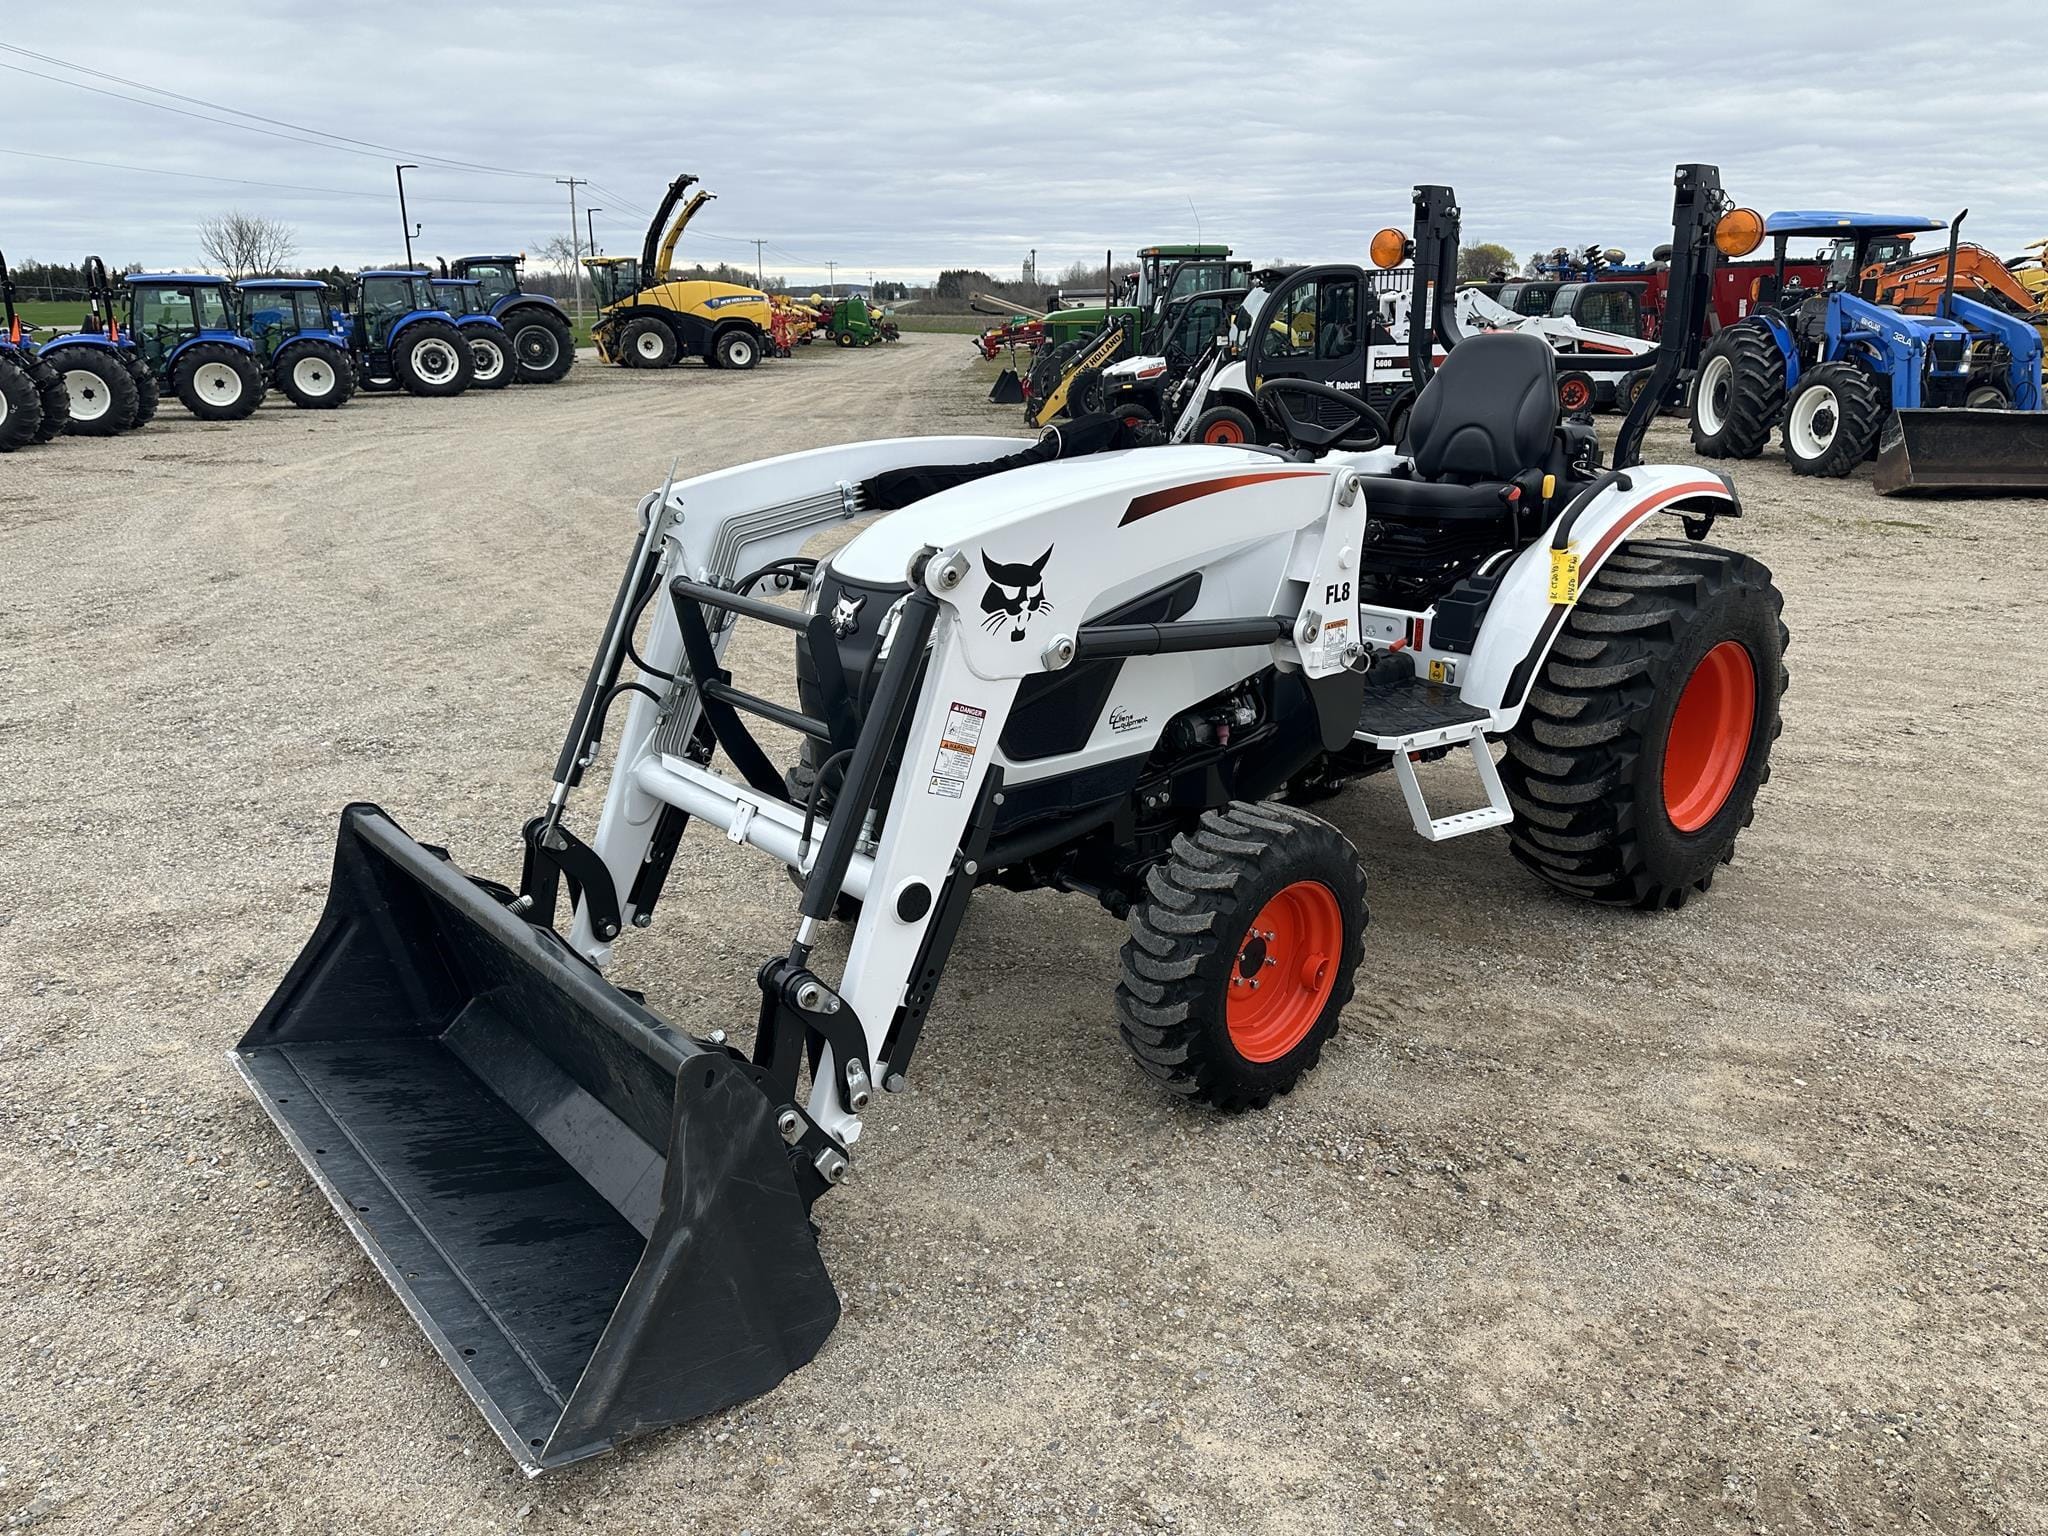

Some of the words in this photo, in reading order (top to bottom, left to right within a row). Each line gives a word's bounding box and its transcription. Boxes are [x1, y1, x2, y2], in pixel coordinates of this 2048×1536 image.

[1904, 266, 1936, 280] DEVELON
[1892, 331, 1912, 347] 32LA
[1089, 334, 1121, 367] HOLLAND
[1375, 359, 1392, 368] 5600
[1336, 380, 1361, 390] Bobcat
[1326, 582, 1350, 605] FL8
[959, 705, 983, 717] DANGER
[948, 742, 973, 753] WARNING
